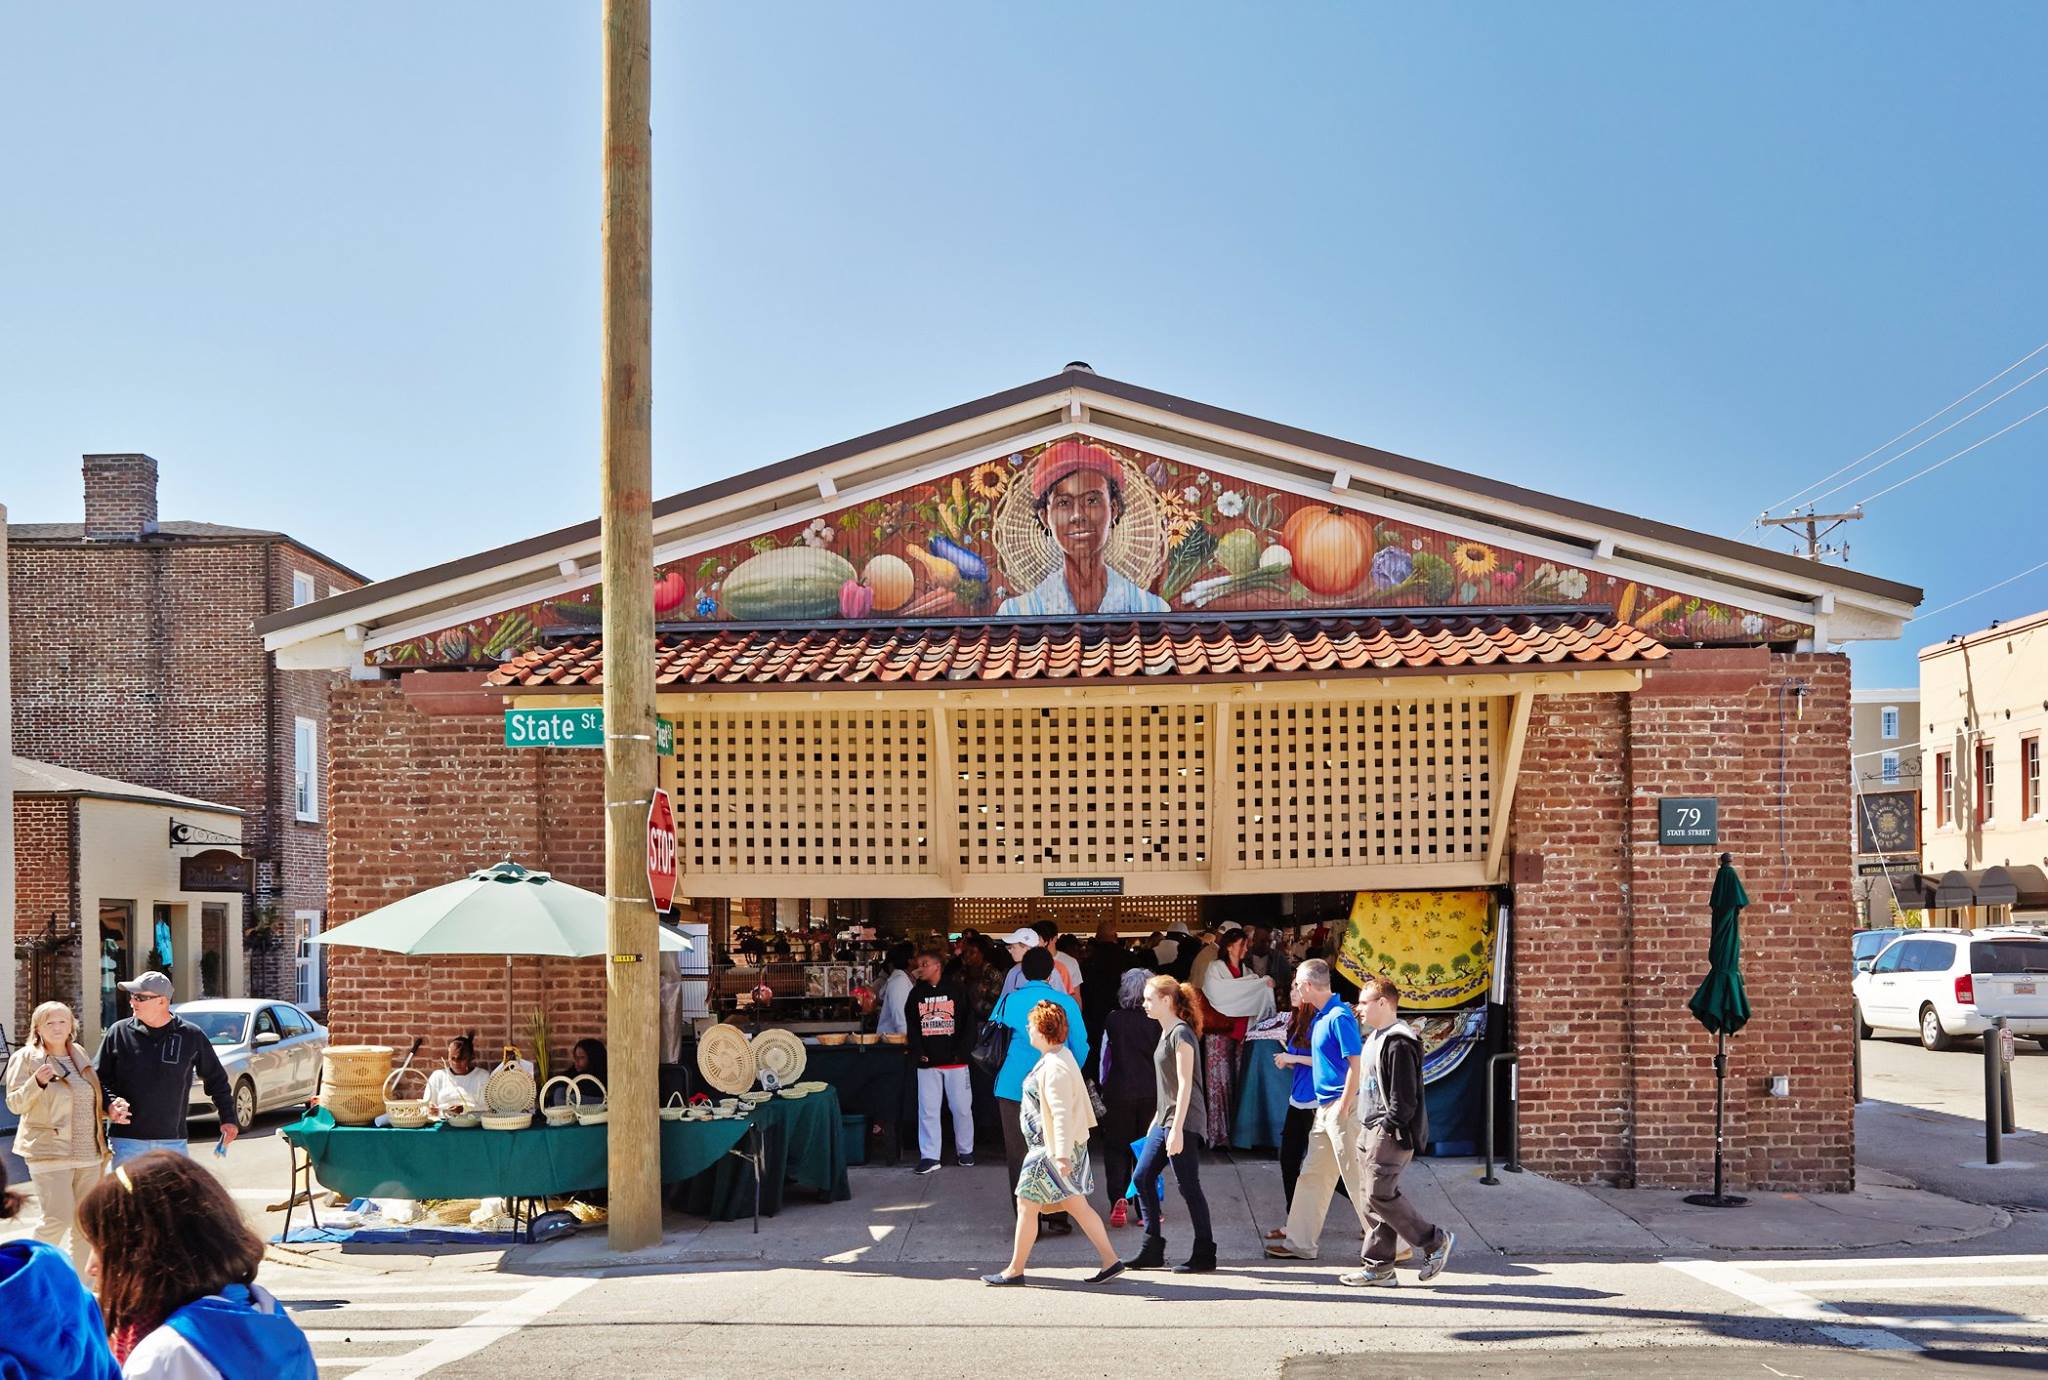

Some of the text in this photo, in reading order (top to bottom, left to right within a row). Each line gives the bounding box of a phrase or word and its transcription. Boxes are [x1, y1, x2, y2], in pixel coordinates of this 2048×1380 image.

[511, 713, 596, 741] State St
[1676, 808, 1701, 827] 79
[1666, 829, 1711, 837] STATE STREET
[649, 827, 675, 875] STOP
